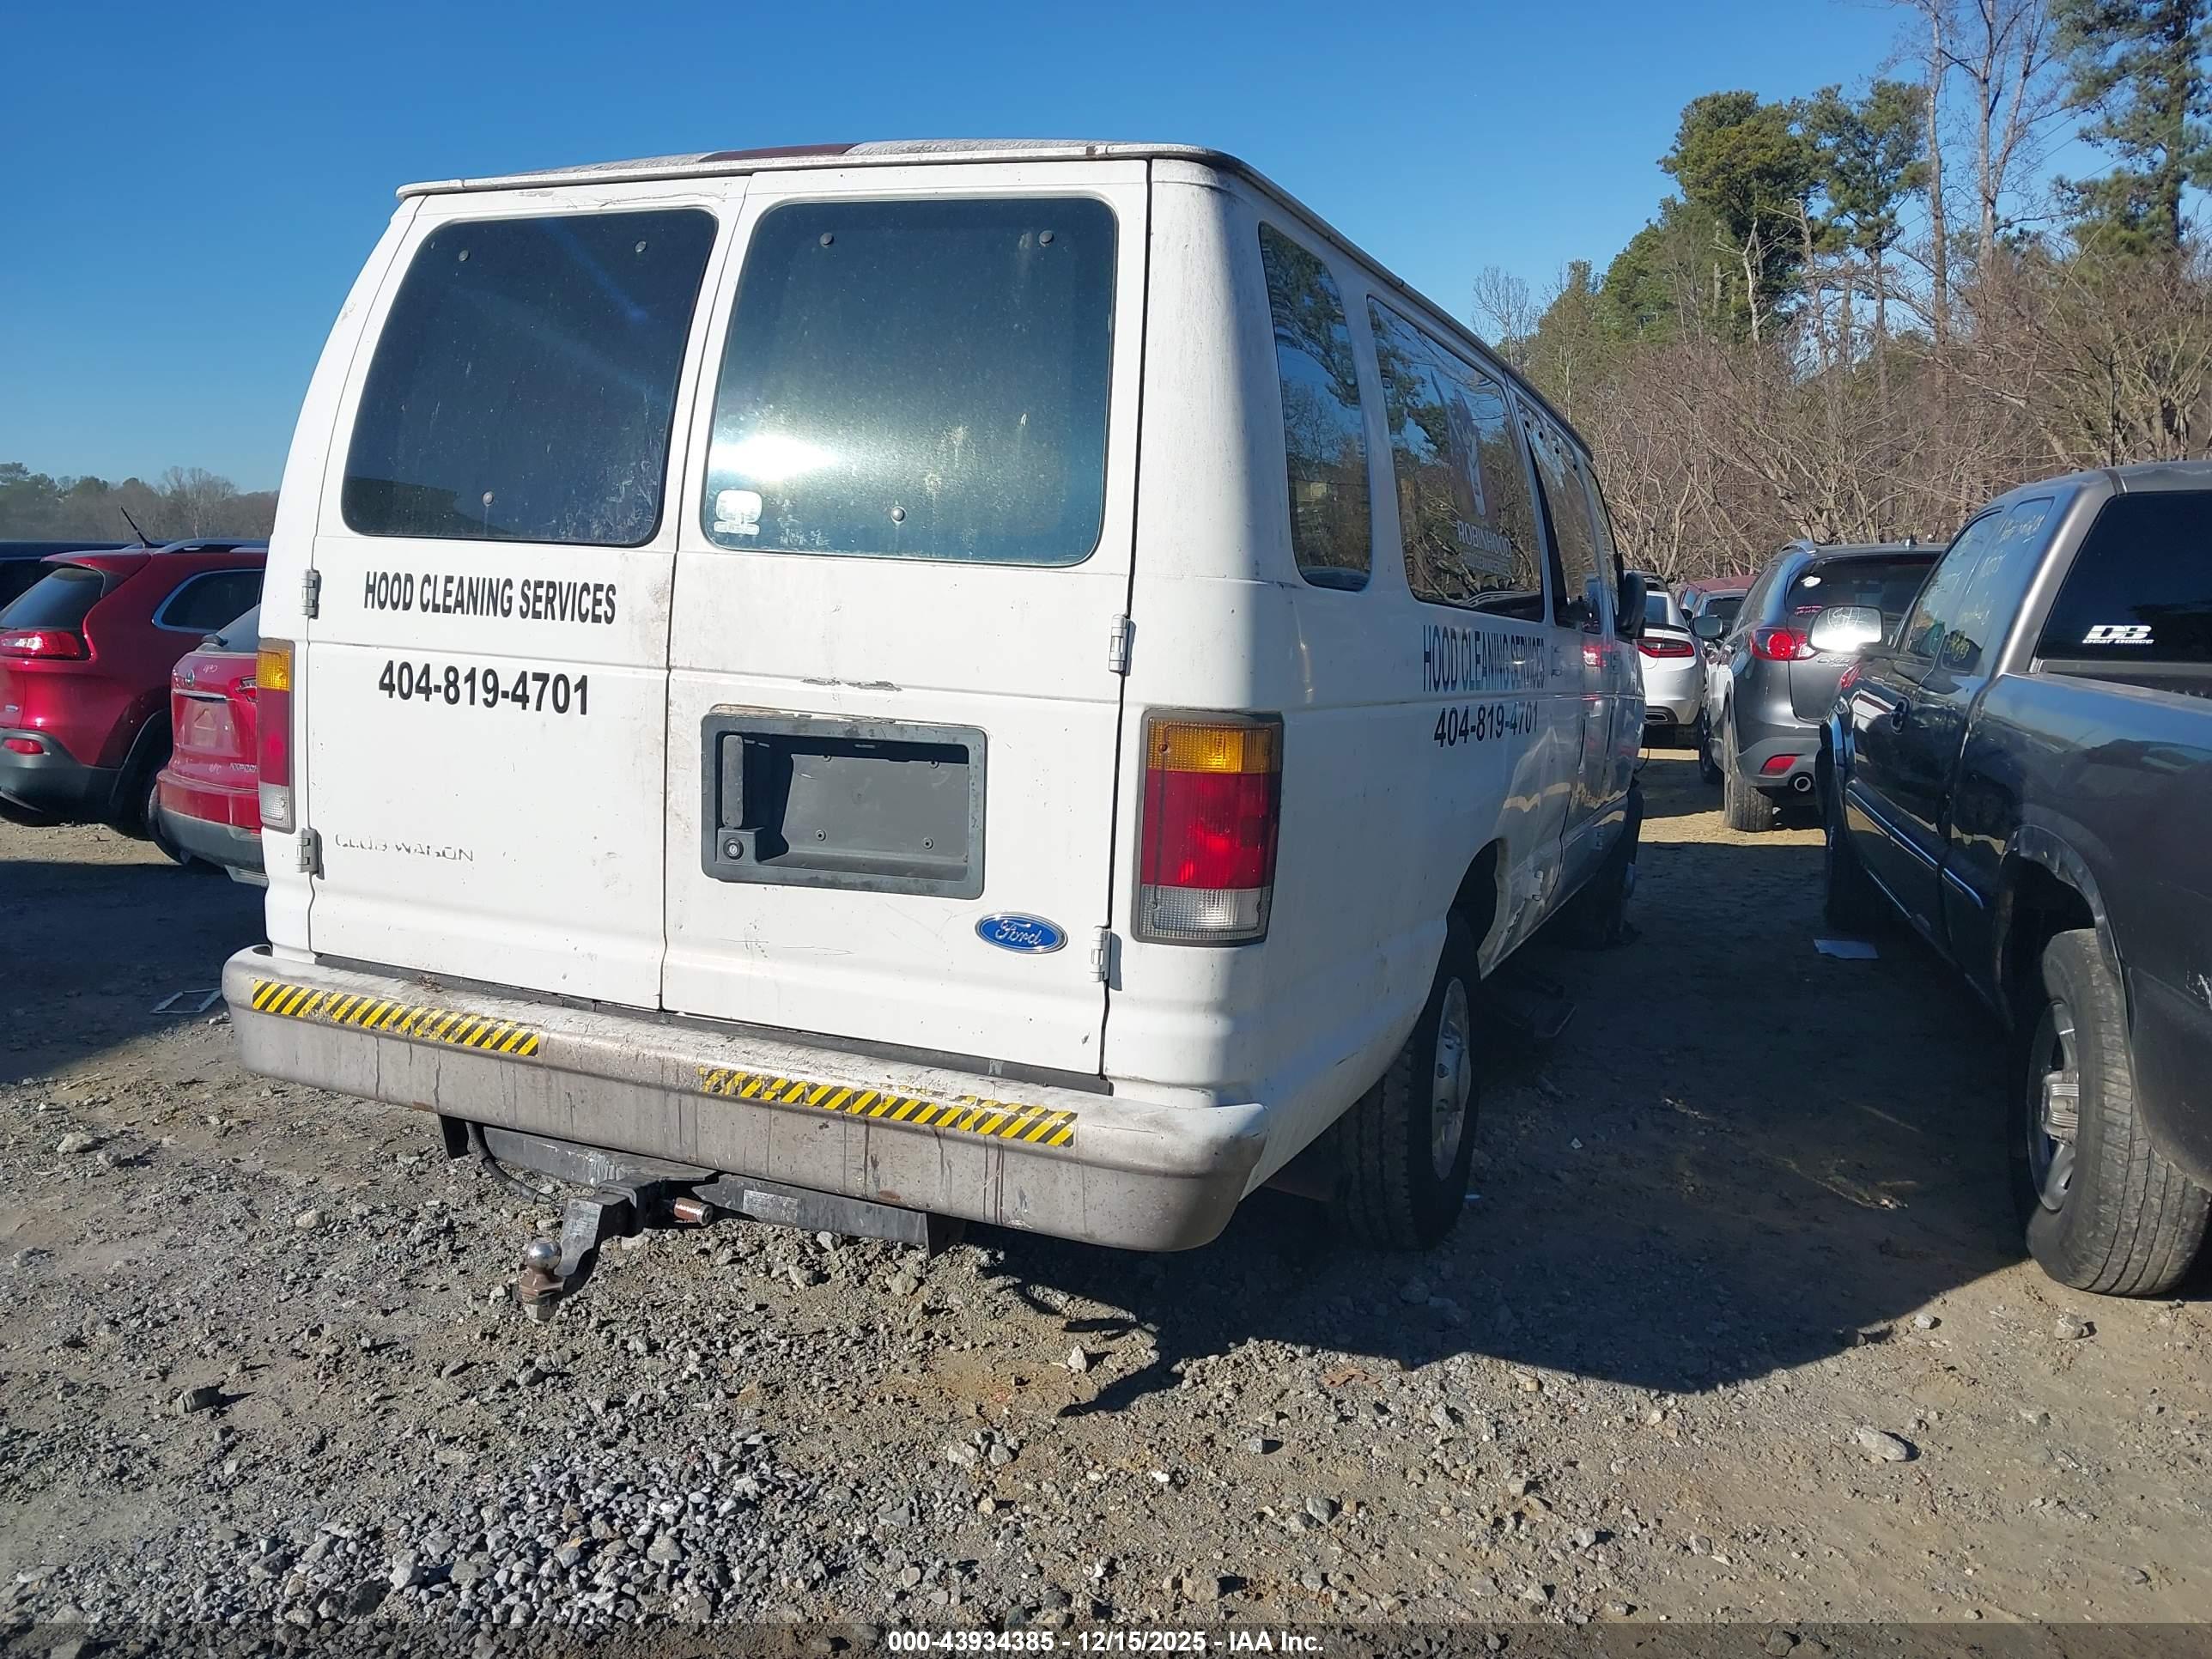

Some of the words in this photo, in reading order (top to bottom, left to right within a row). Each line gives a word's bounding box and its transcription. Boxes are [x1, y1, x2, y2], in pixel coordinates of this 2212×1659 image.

[1456, 520, 1512, 559] ROBINHOOD
[364, 570, 415, 612] HOOD
[419, 573, 514, 618] CLEANING
[519, 579, 617, 625] SERVICES
[1423, 624, 1458, 693] HOOD
[1462, 628, 1510, 691] CLEANING
[378, 659, 589, 716] 404-819-4701
[1434, 700, 1539, 748] 404-819-4701
[994, 919, 1042, 945] Ford
